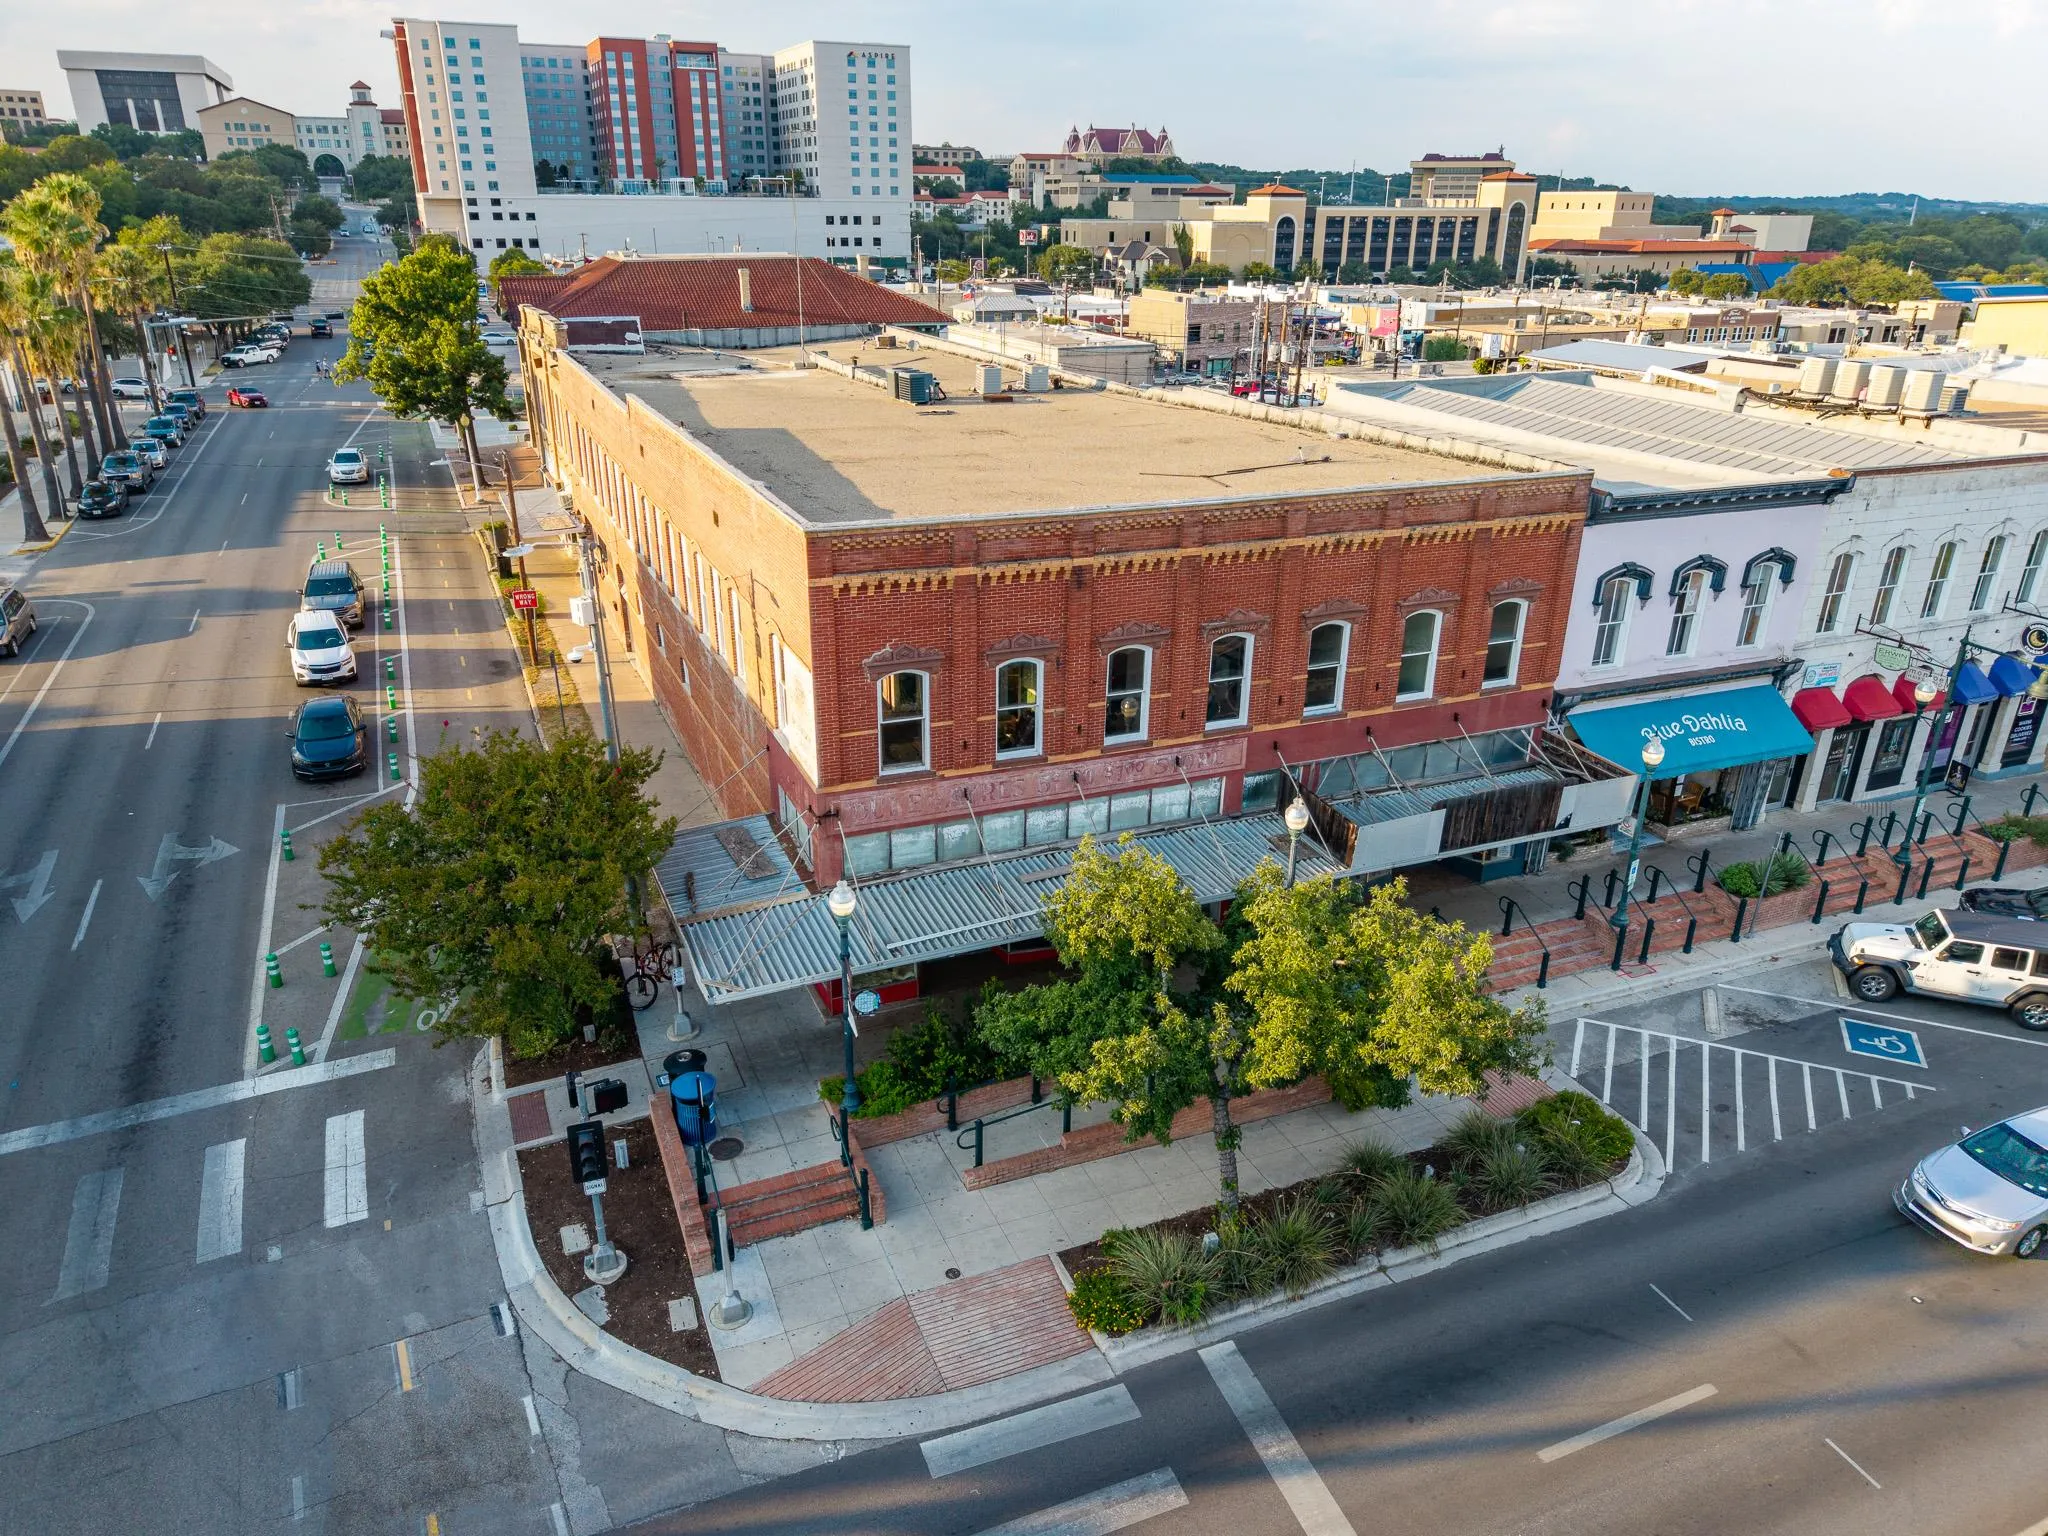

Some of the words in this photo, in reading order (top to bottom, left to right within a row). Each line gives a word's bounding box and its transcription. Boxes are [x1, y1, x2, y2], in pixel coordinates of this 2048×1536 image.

[861, 51, 896, 60] ASPIRE
[514, 593, 536, 601] WRONG
[1878, 647, 1909, 660] ERWIN
[1908, 668, 1945, 683] monoe
[1640, 723, 1685, 741] Blue
[1681, 712, 1748, 732] Dahlia
[2013, 724, 2033, 733] COOKIES
[1687, 734, 1716, 747] BISTRO
